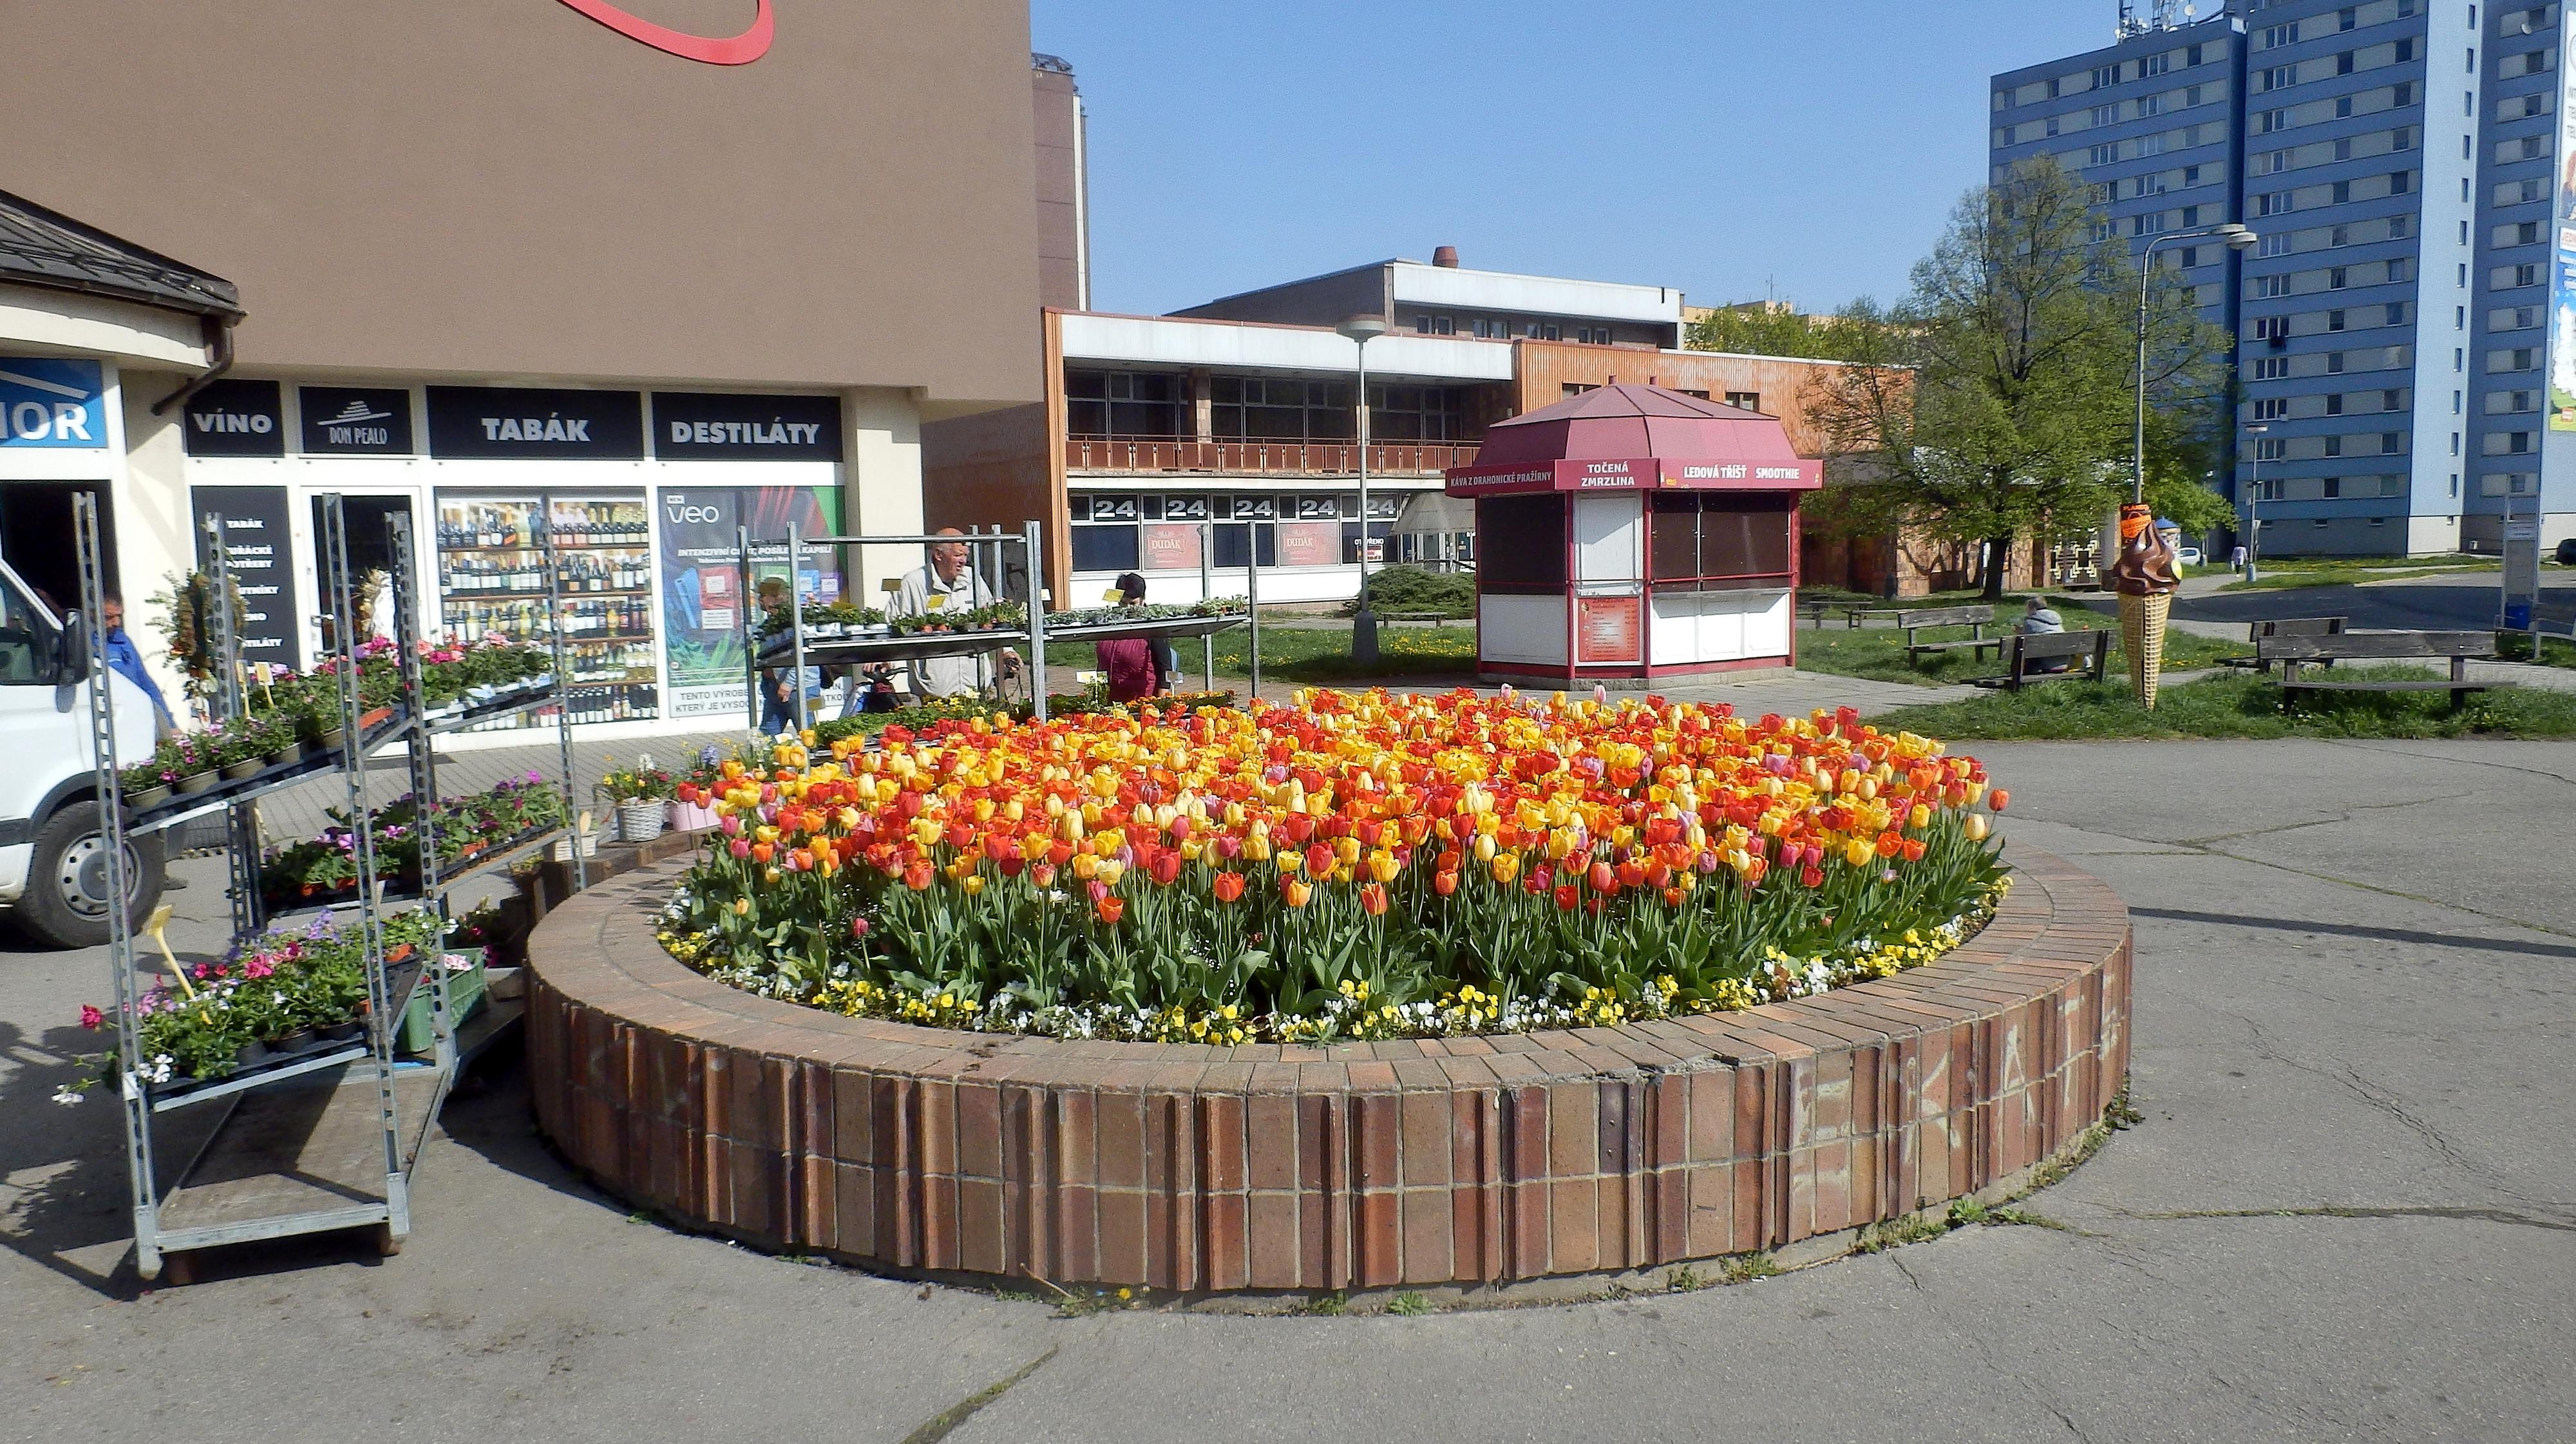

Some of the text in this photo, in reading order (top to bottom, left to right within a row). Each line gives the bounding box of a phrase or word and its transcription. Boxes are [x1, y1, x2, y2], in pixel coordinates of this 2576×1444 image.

[193, 408, 273, 433] VÍNO
[481, 412, 591, 442] TABÁK
[329, 426, 388, 445] DON PEALO
[670, 417, 820, 444] DESTILÁTY
[1587, 461, 1629, 473] TOČENÁ
[1683, 464, 1719, 479] LEDOVÁ
[1756, 467, 1800, 479] SMOOTHIE
[1450, 476, 1468, 487] KÁVA
[1473, 471, 1515, 485] DRAHONICKÉ
[1517, 470, 1552, 483] PRAŽÍRNY
[1581, 476, 1635, 487] ZMRZLINA
[667, 506, 719, 524] veo
[1095, 500, 1136, 517] 24
[1168, 500, 1206, 517] 24
[1235, 499, 1271, 517] 24
[1301, 499, 1335, 516] 24
[226, 518, 264, 528] TABÁK
[1151, 538, 1182, 549] DUDÁK
[1287, 537, 1314, 547] DUDÁK
[681, 691, 710, 700] TENTO
[714, 688, 749, 699] VÝROBE
[676, 701, 705, 712] KTERÝ
[708, 702, 719, 710] JE
